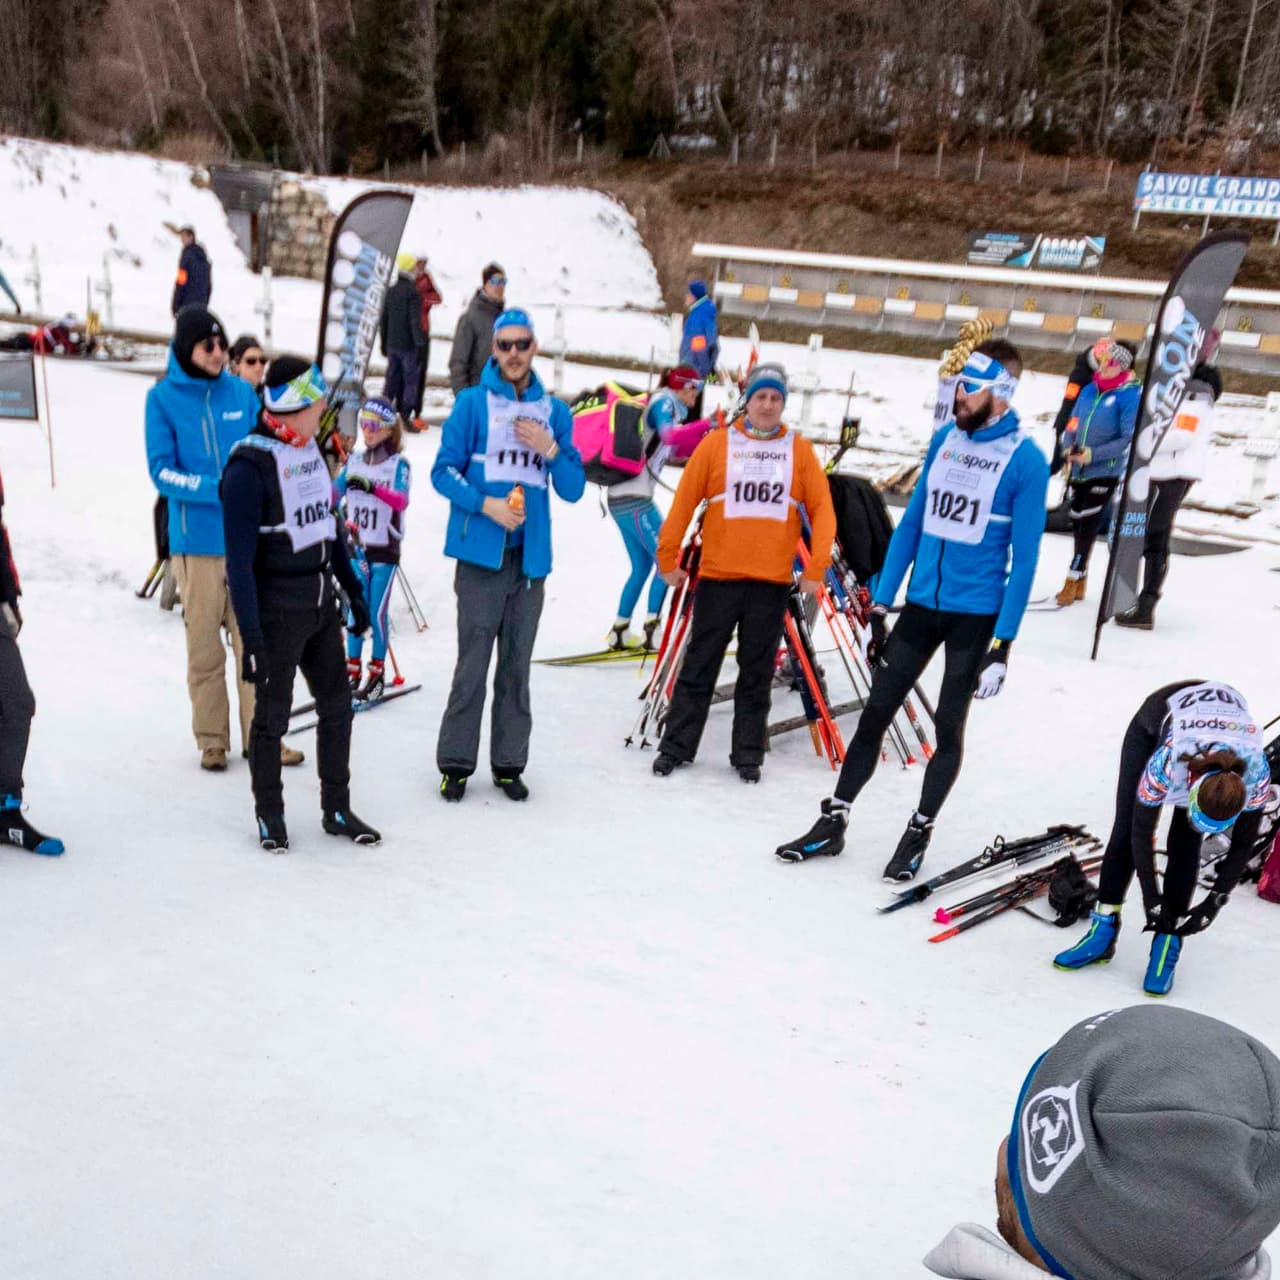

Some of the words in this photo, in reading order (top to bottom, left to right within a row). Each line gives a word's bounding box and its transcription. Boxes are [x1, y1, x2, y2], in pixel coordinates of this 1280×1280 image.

[1142, 174, 1210, 195] SAVOIE
[1214, 177, 1280, 198] GRAND
[352, 251, 391, 381] EXPERIENCE
[498, 449, 543, 471] 1114
[940, 449, 1001, 472] ekosport
[733, 480, 785, 504] 1062
[930, 487, 981, 526] 1021
[1180, 718, 1257, 734] ekosport
